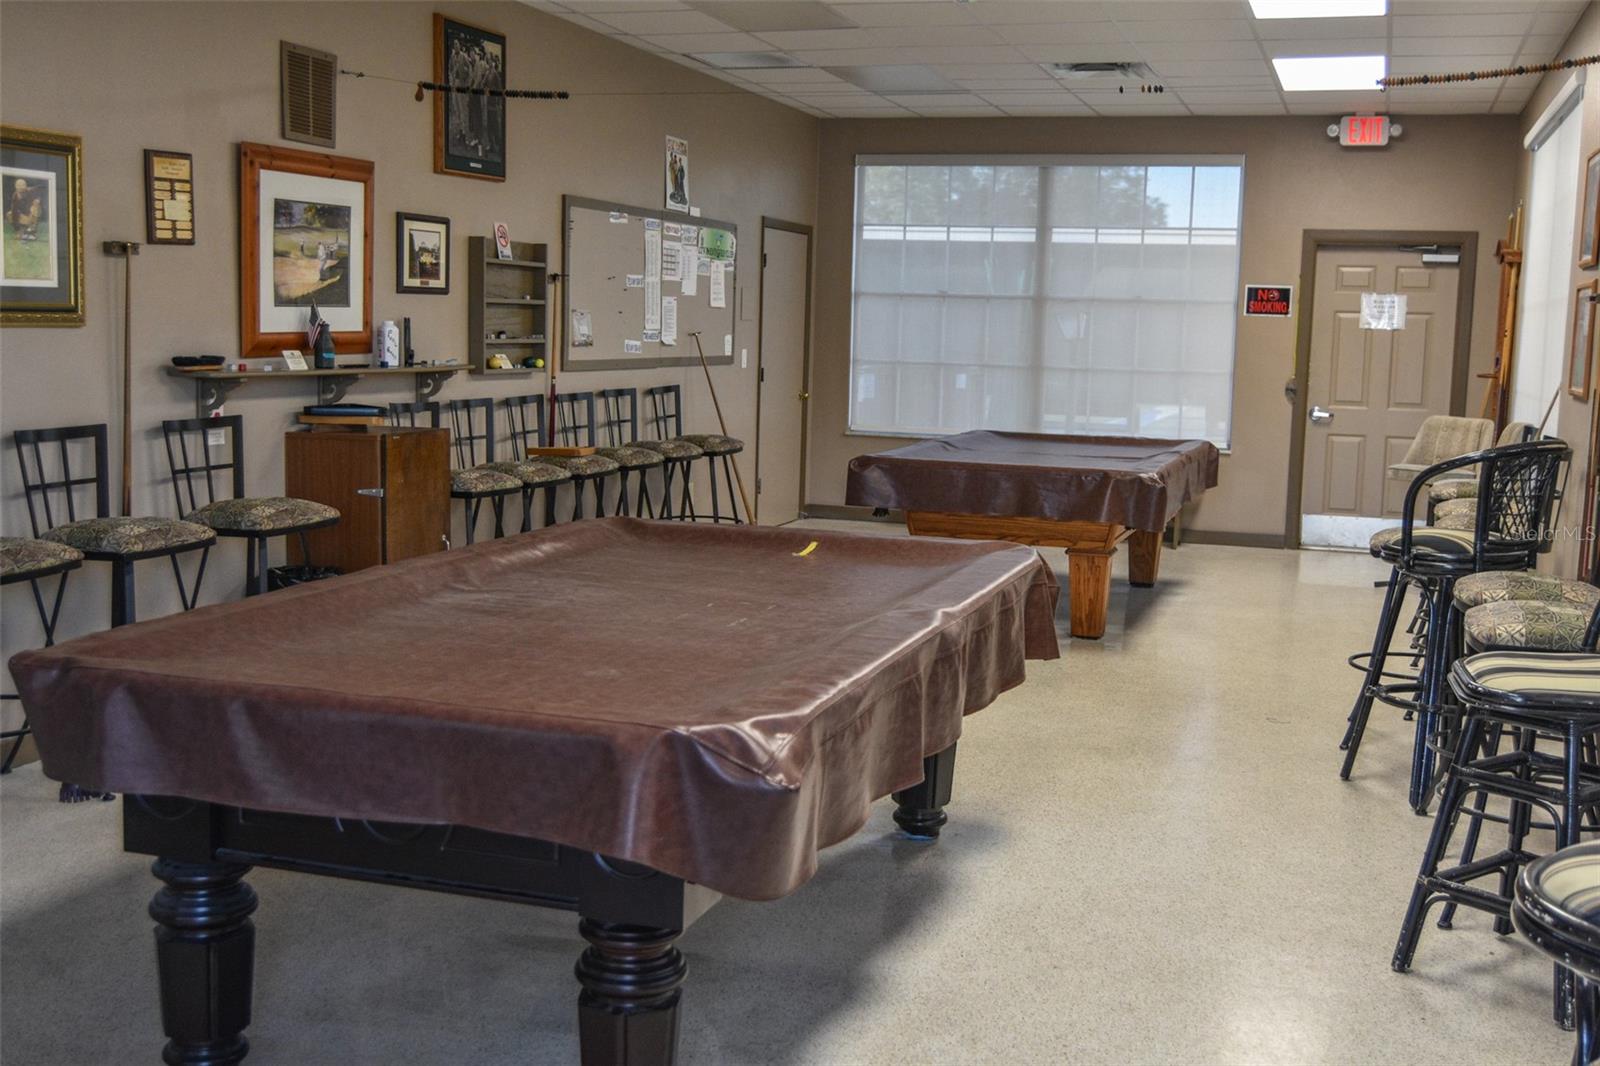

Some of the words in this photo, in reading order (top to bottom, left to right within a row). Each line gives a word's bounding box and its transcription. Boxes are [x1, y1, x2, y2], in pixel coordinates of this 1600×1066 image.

[1349, 117, 1383, 144] EXIT
[1257, 288, 1280, 301] NO
[1248, 301, 1287, 313] SMOKING
